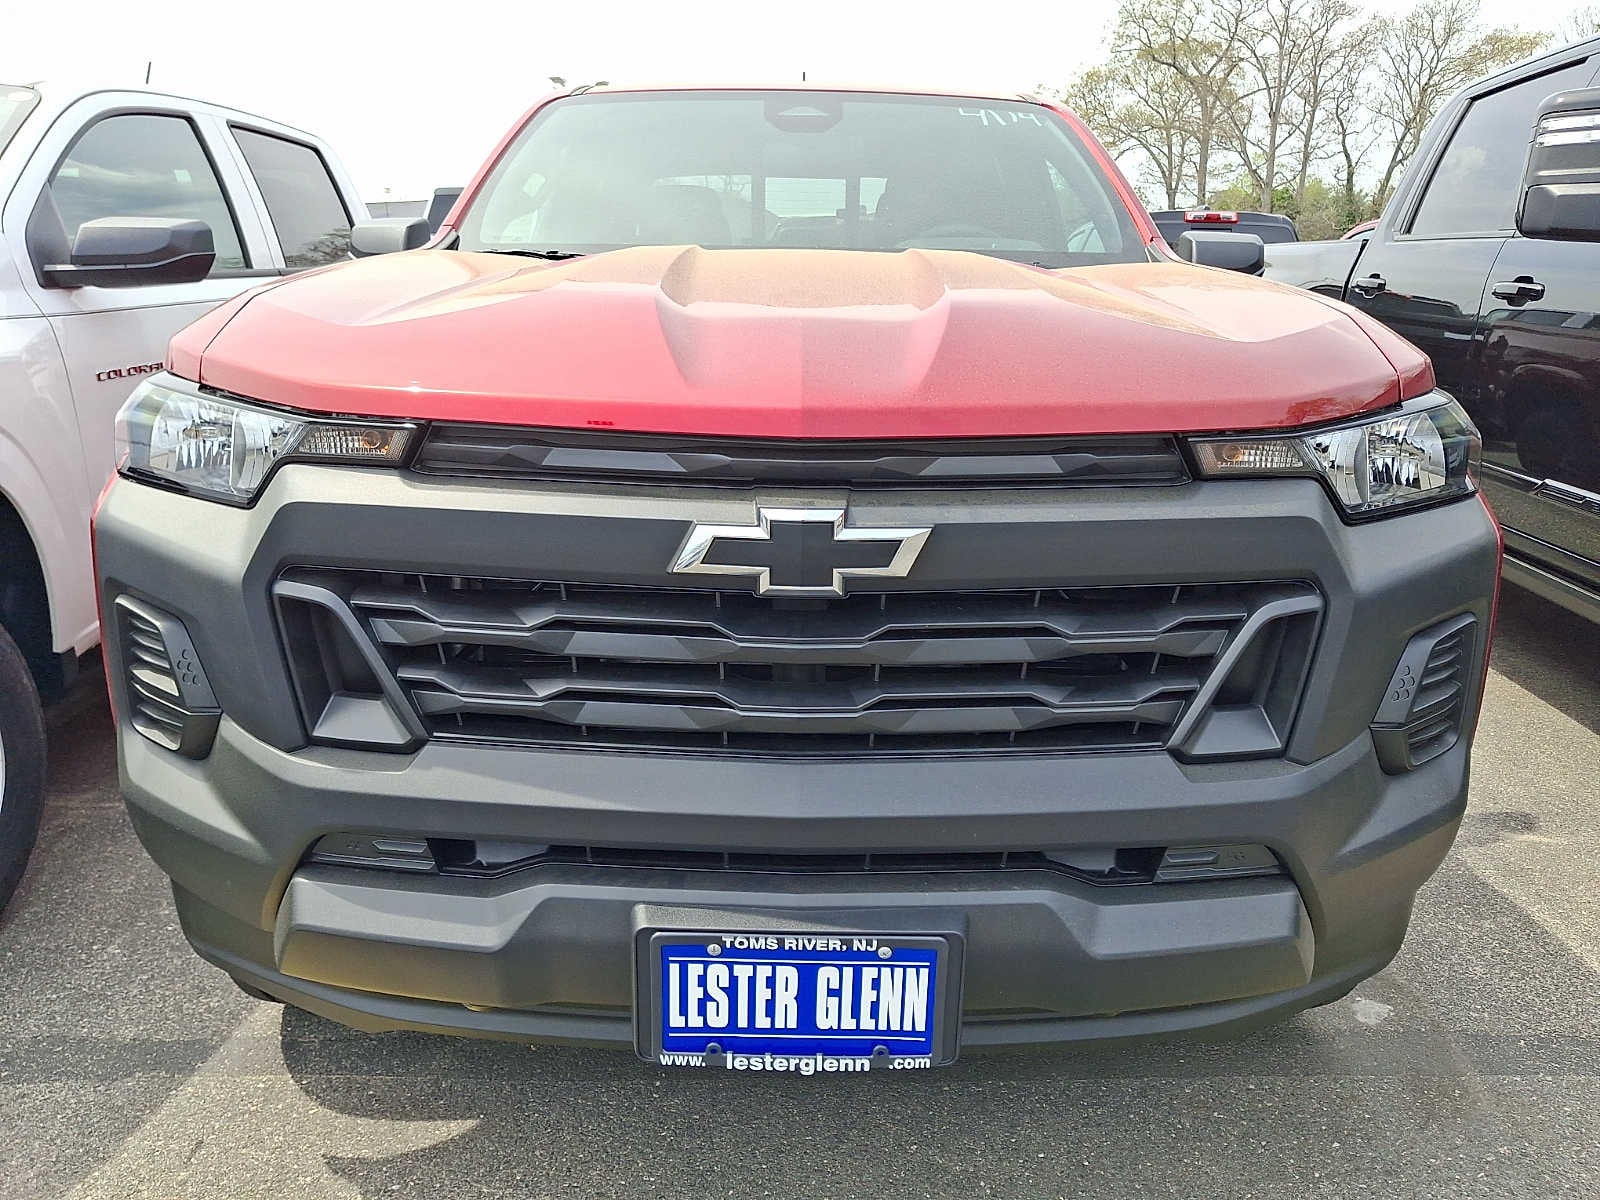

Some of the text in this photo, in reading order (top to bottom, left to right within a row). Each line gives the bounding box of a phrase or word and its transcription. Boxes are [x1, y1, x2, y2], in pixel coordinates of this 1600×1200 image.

[96, 361, 164, 381] COLORA
[721, 936, 878, 952] TOMS RIVER, NJ
[668, 963, 929, 1032] LESTER GLENN
[659, 1052, 930, 1075] www. lesterglenn .com
